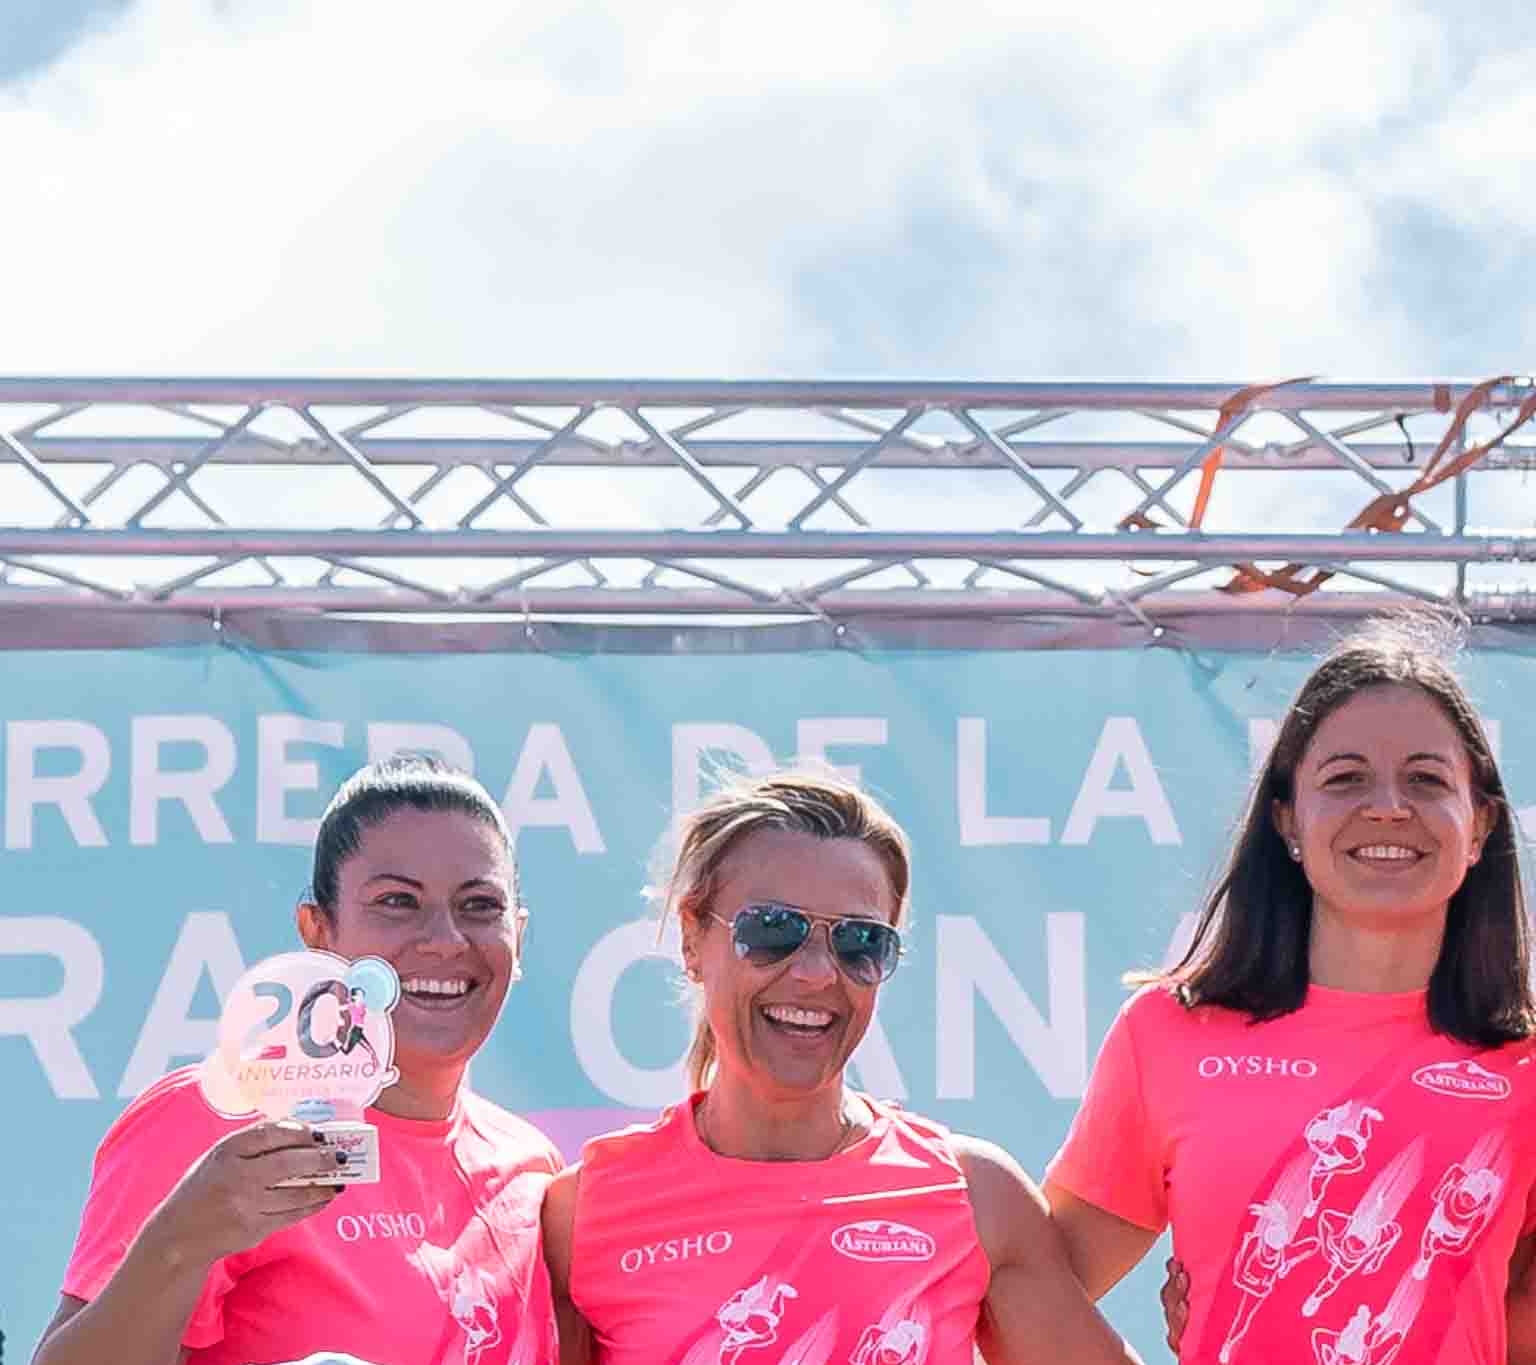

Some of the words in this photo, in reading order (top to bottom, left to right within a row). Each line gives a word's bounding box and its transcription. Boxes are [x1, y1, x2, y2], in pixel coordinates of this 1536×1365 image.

[957, 717, 1182, 845] LA
[240, 980, 351, 1060] 20
[1198, 1055, 1318, 1078] OYSHO
[336, 1211, 425, 1242] OYSHO
[621, 1231, 733, 1273] OYSHO
